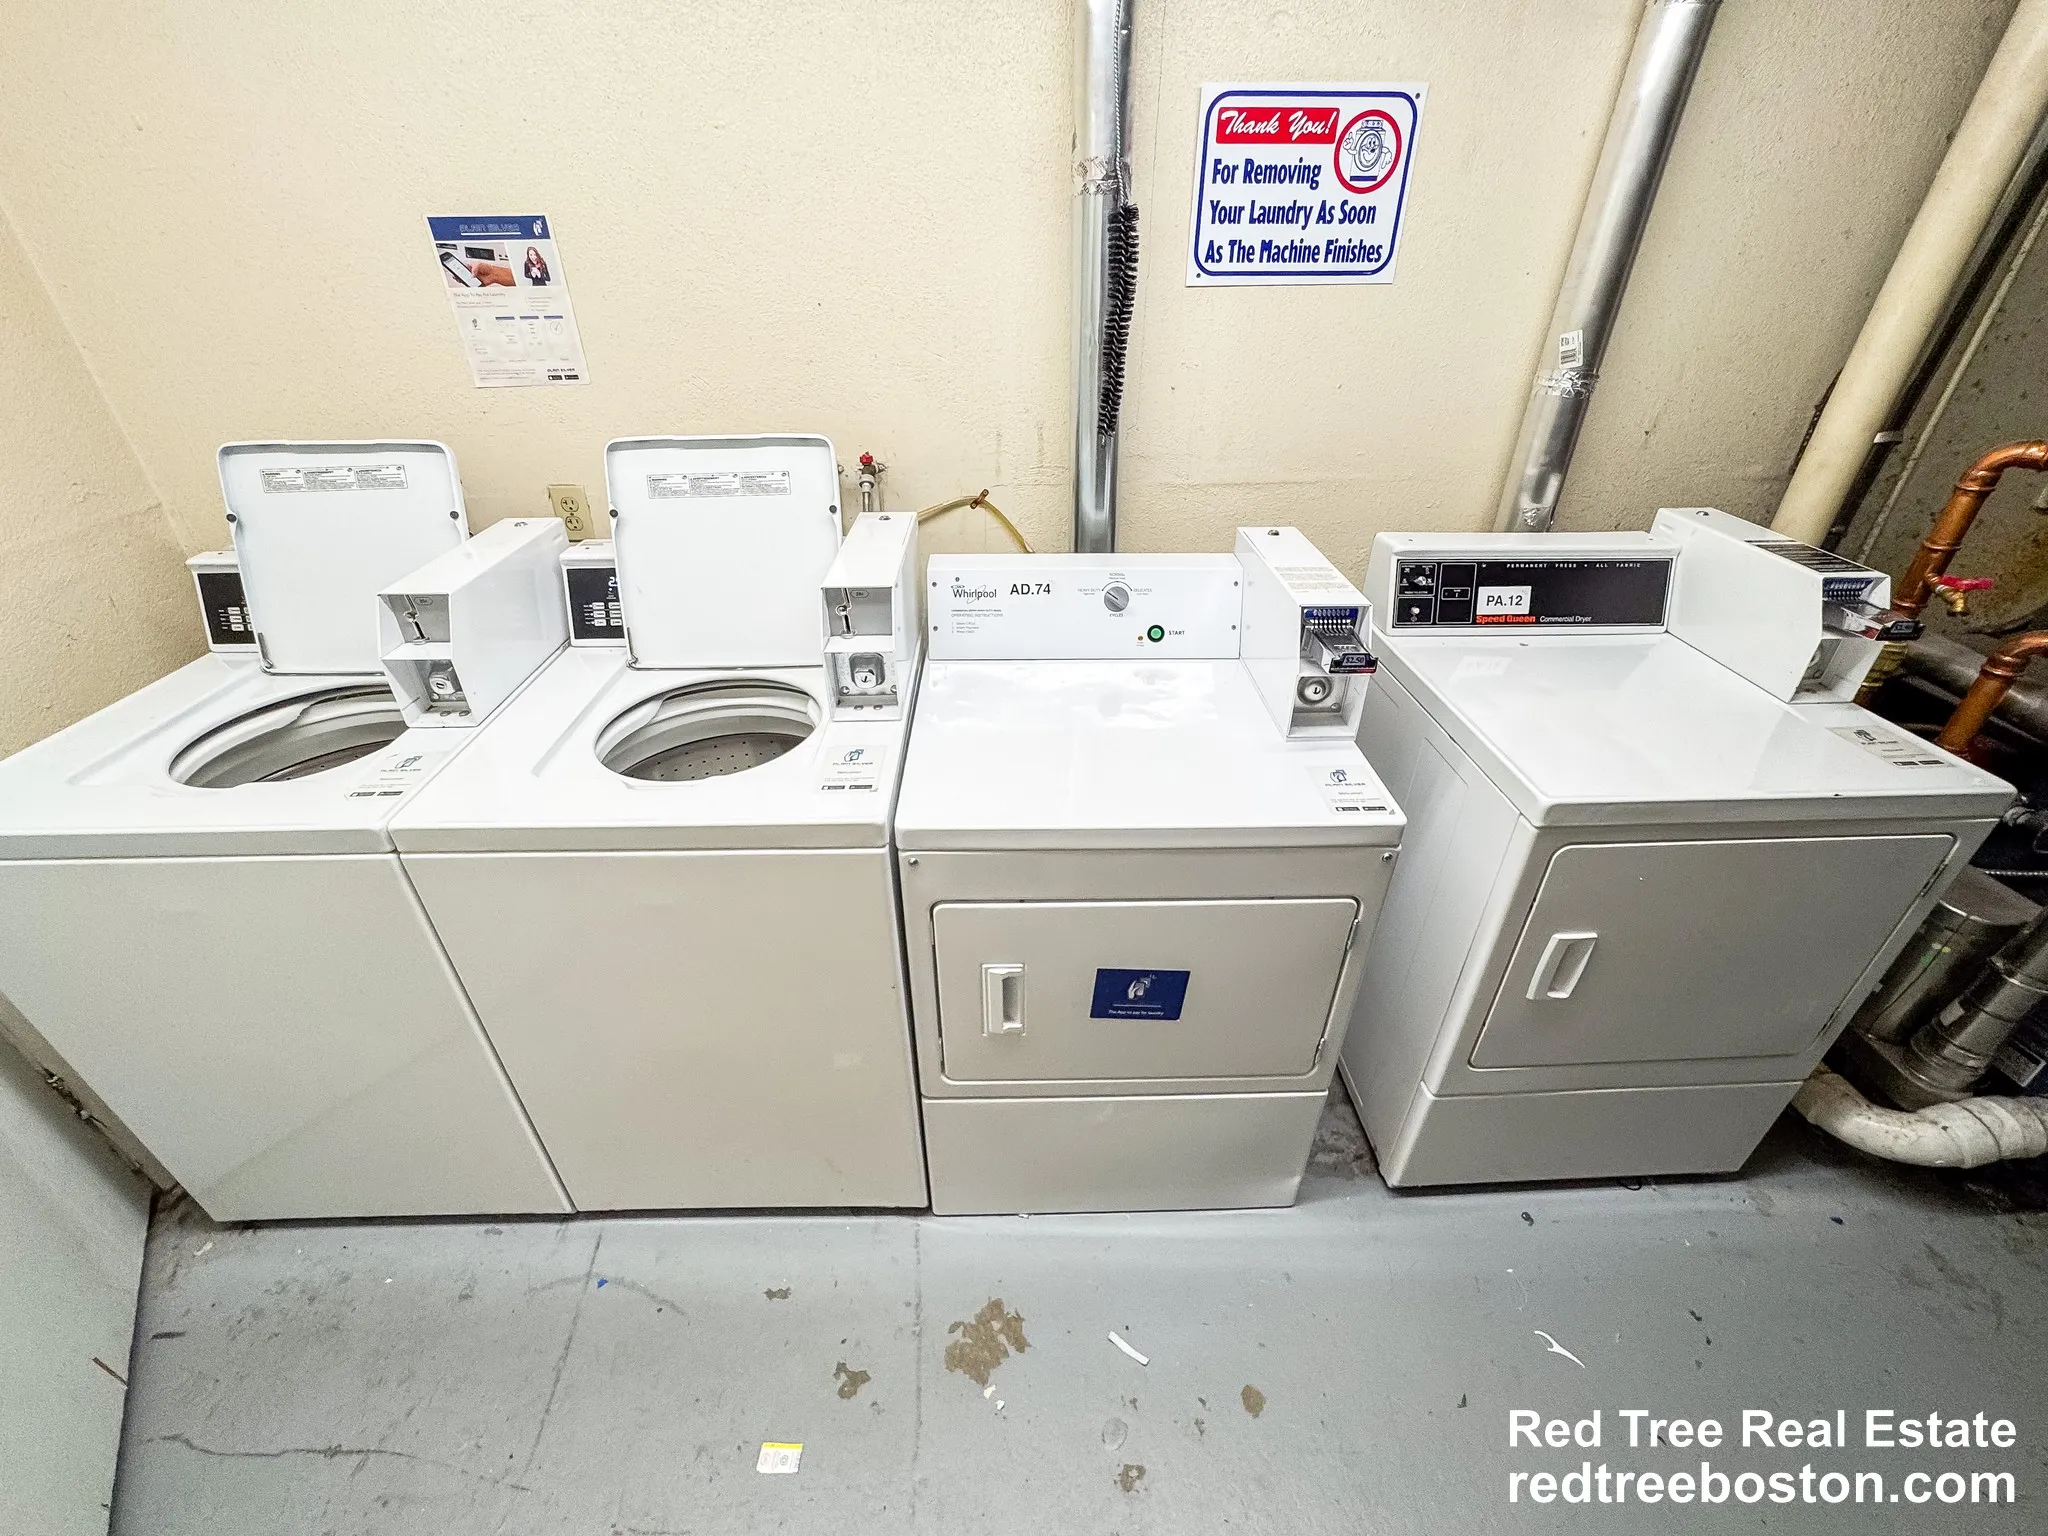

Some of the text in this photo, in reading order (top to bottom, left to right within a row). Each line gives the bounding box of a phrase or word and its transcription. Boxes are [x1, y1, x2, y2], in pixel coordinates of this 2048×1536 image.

[1220, 110, 1338, 141] Thank You!
[1211, 156, 1322, 190] For Removing
[1209, 199, 1377, 230] Your Laundry As Soon
[1204, 238, 1383, 263] As The Machine Finishes
[953, 589, 997, 600] Whirlpool
[1010, 583, 1051, 595] AD.74
[1486, 595, 1523, 606] PA.12
[1476, 615, 1505, 624] Speed
[1575, 615, 1592, 623] Dryer
